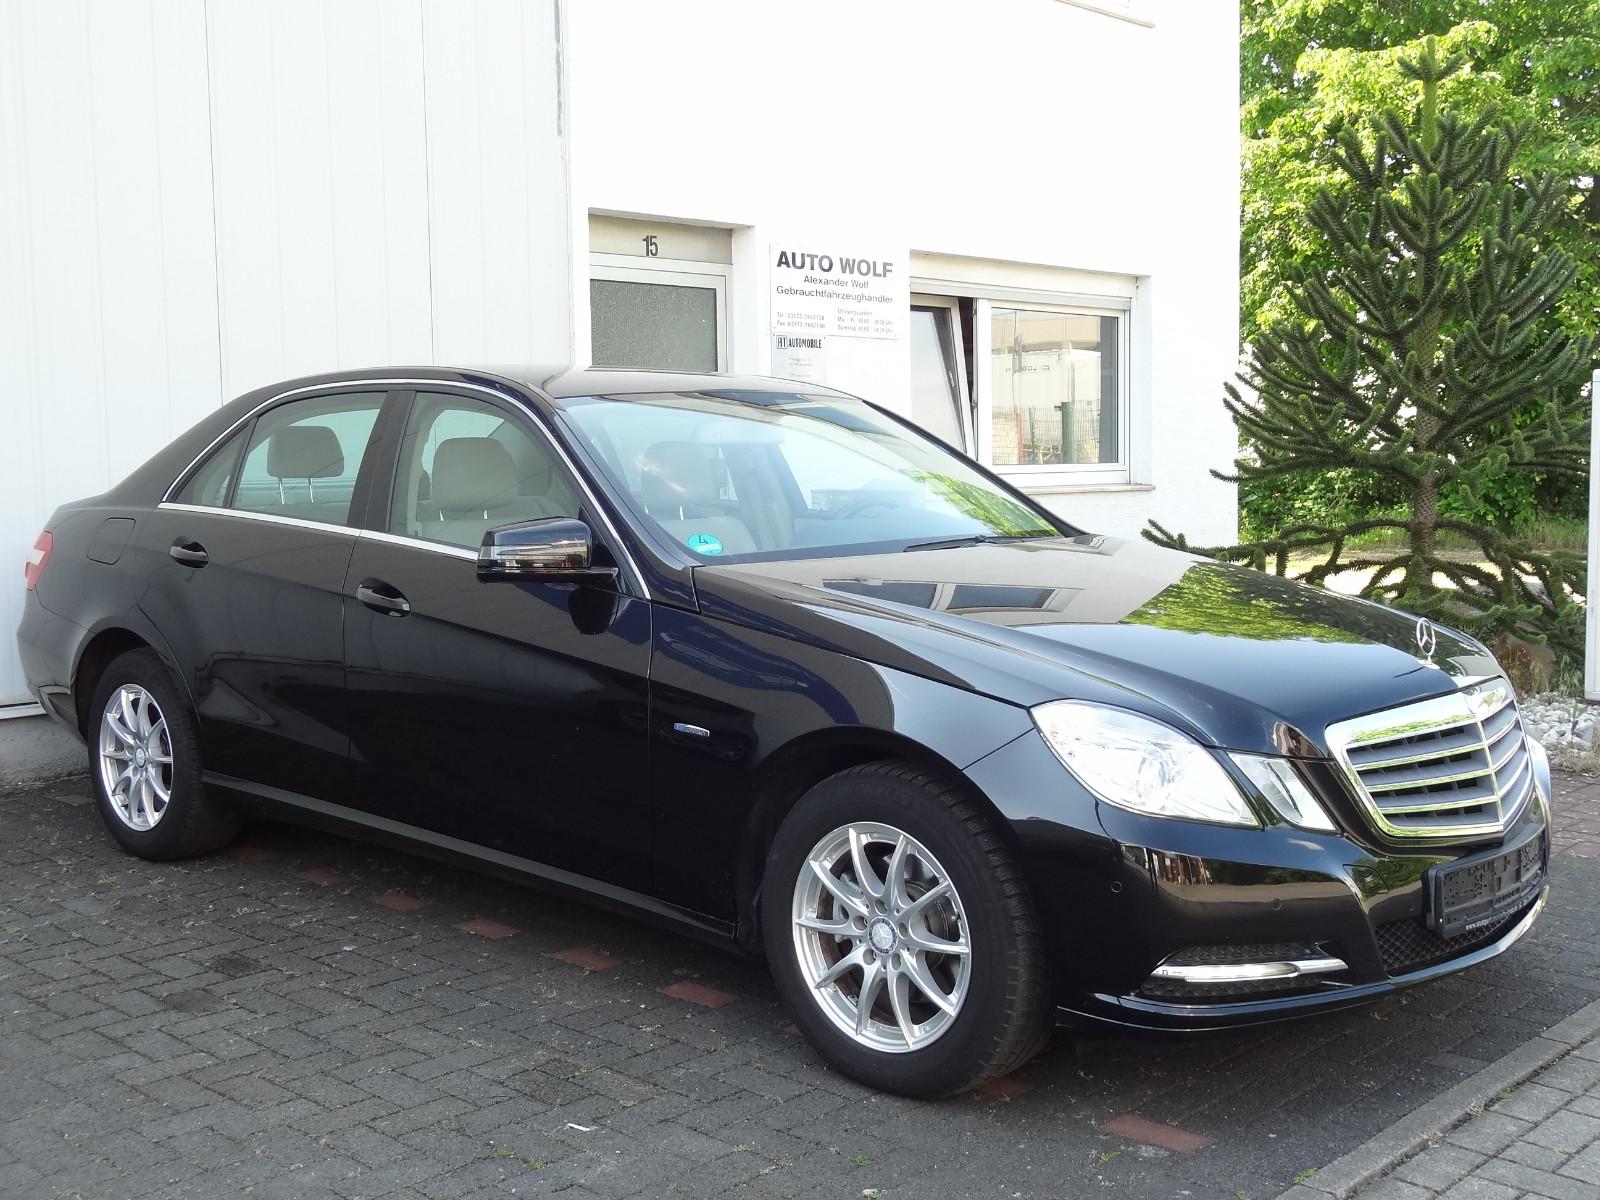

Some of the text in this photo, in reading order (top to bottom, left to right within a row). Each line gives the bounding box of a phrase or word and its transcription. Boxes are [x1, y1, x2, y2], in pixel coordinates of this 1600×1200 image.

[642, 235, 659, 257] 15
[776, 250, 894, 278] AUTO WOLF
[804, 275, 849, 287] Alexander
[788, 337, 822, 349] AUTOMOBILE
